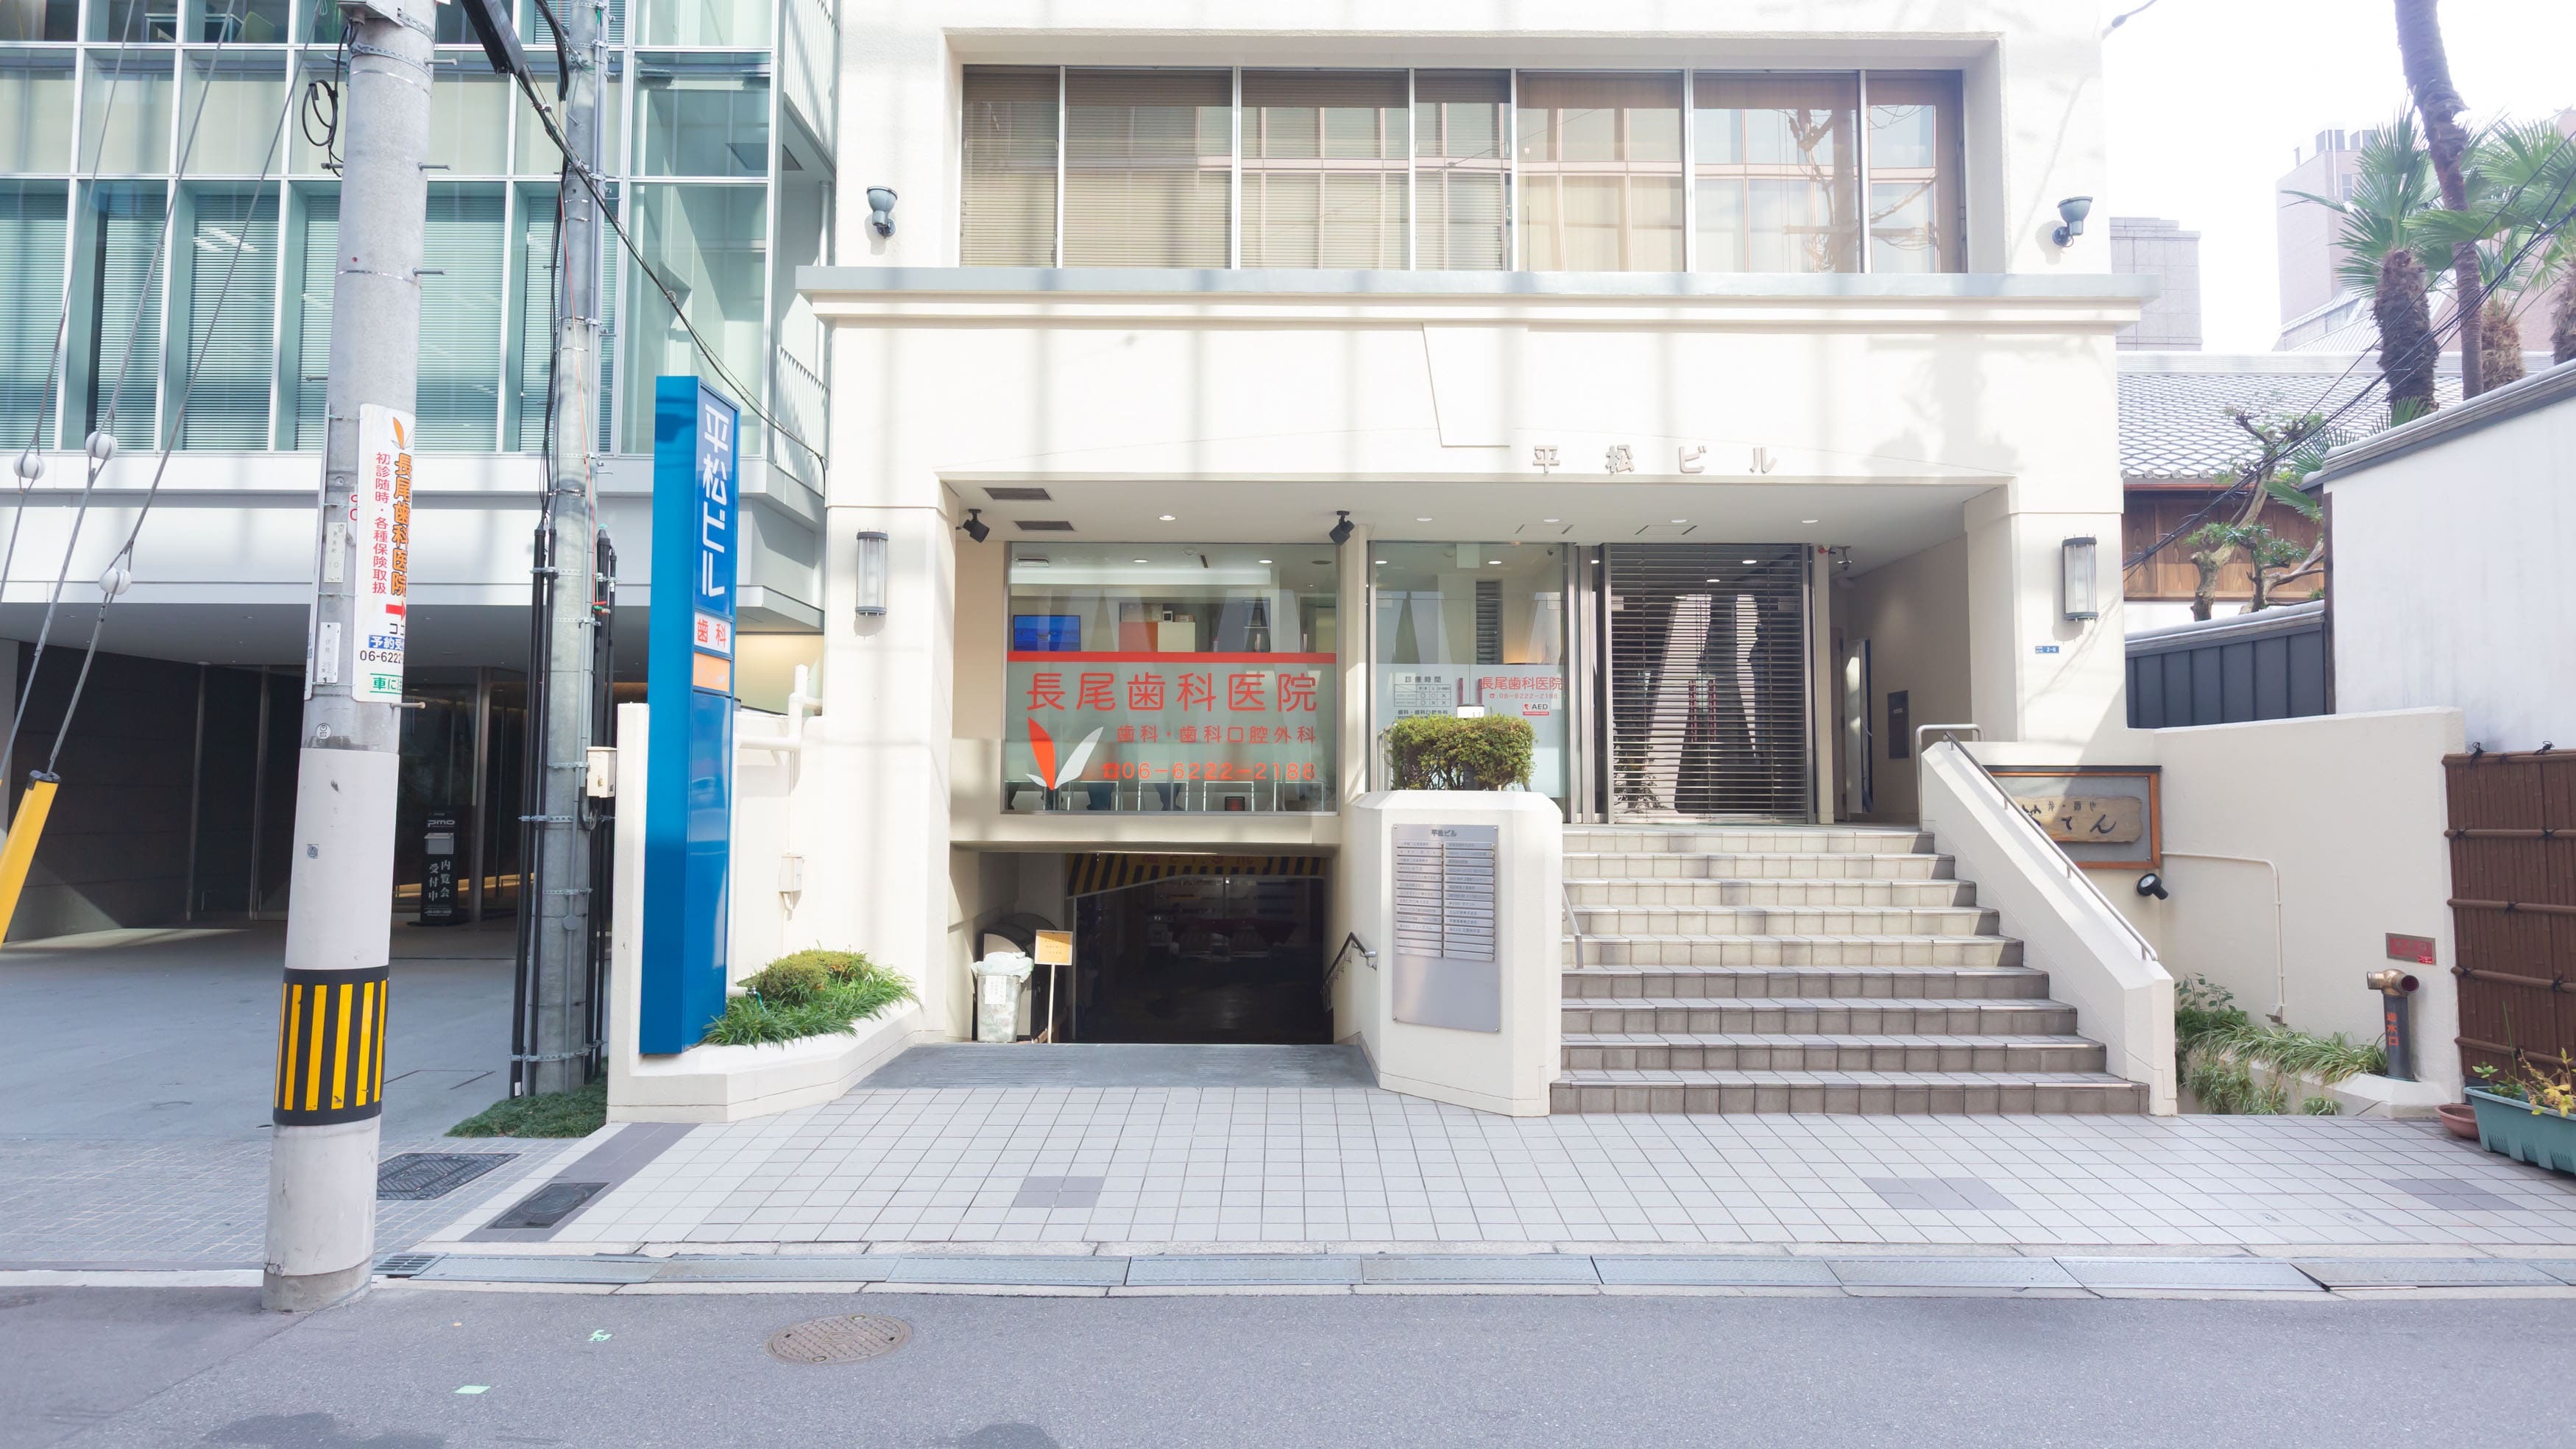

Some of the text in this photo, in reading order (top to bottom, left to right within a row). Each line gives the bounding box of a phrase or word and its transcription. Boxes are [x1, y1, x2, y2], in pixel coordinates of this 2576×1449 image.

[1532, 444, 1778, 475] 平松ビル
[701, 403, 729, 598] 平松ビル
[372, 452, 391, 595] 初診随時・各種保険取扱
[390, 452, 412, 598] 長尾歯科医院
[697, 620, 726, 648] 歯科
[1026, 671, 1317, 712] 長尾歯科医院
[1481, 676, 1564, 690] 長尾歯科医院
[1117, 725, 1316, 744] 歯科・歯科口腔外科
[1122, 762, 1316, 780] 06-6222-2188
[428, 820, 456, 828] pmo
[428, 863, 439, 901] 受付中
[440, 860, 451, 898] 内覧会
